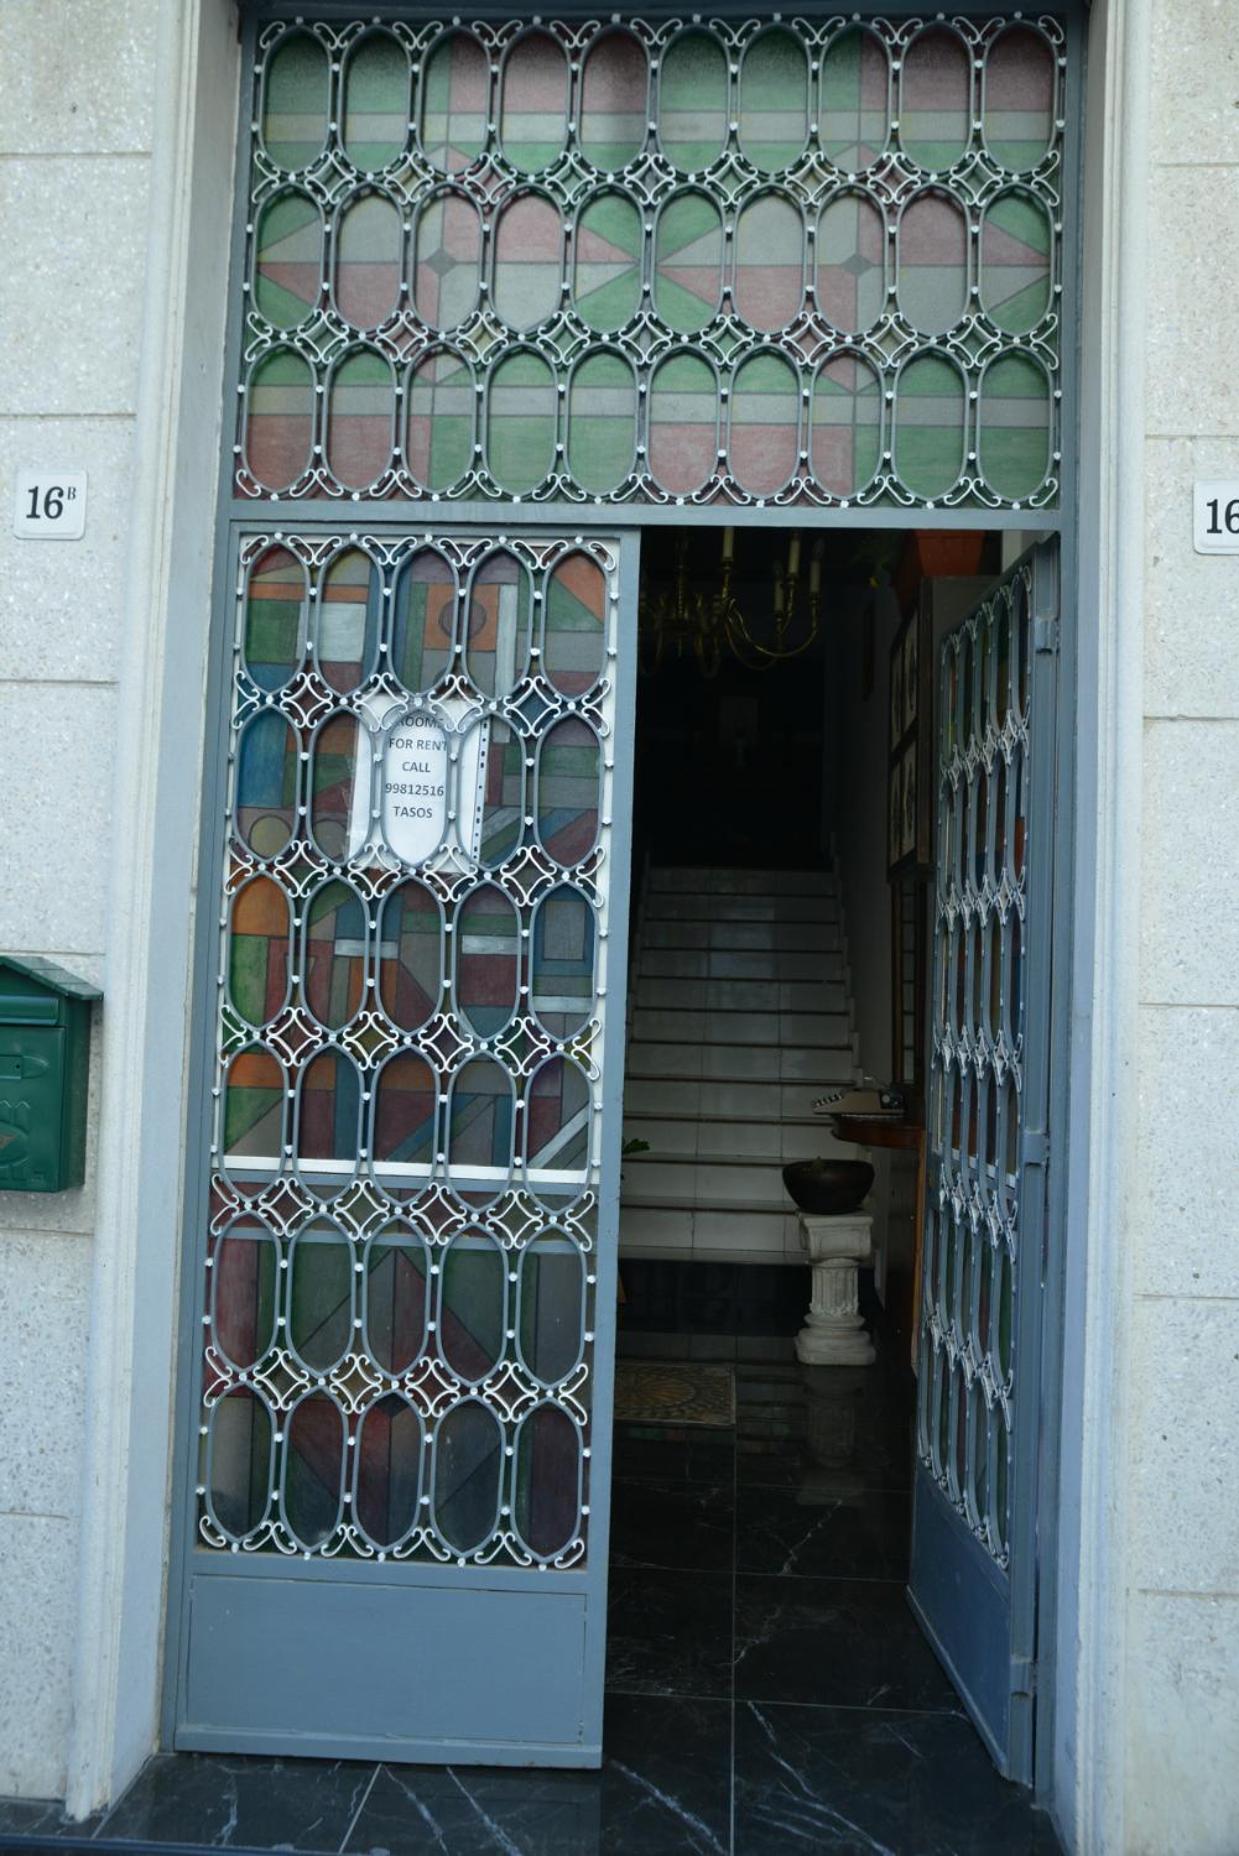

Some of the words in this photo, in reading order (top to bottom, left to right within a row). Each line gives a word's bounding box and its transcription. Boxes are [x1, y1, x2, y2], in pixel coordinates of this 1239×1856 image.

[1206, 498, 1239, 534] 16
[389, 738, 413, 750] FOR
[417, 739, 447, 751] RENT
[402, 761, 431, 773] CALL
[385, 783, 444, 797] 99812516
[393, 806, 433, 819] TASOS
